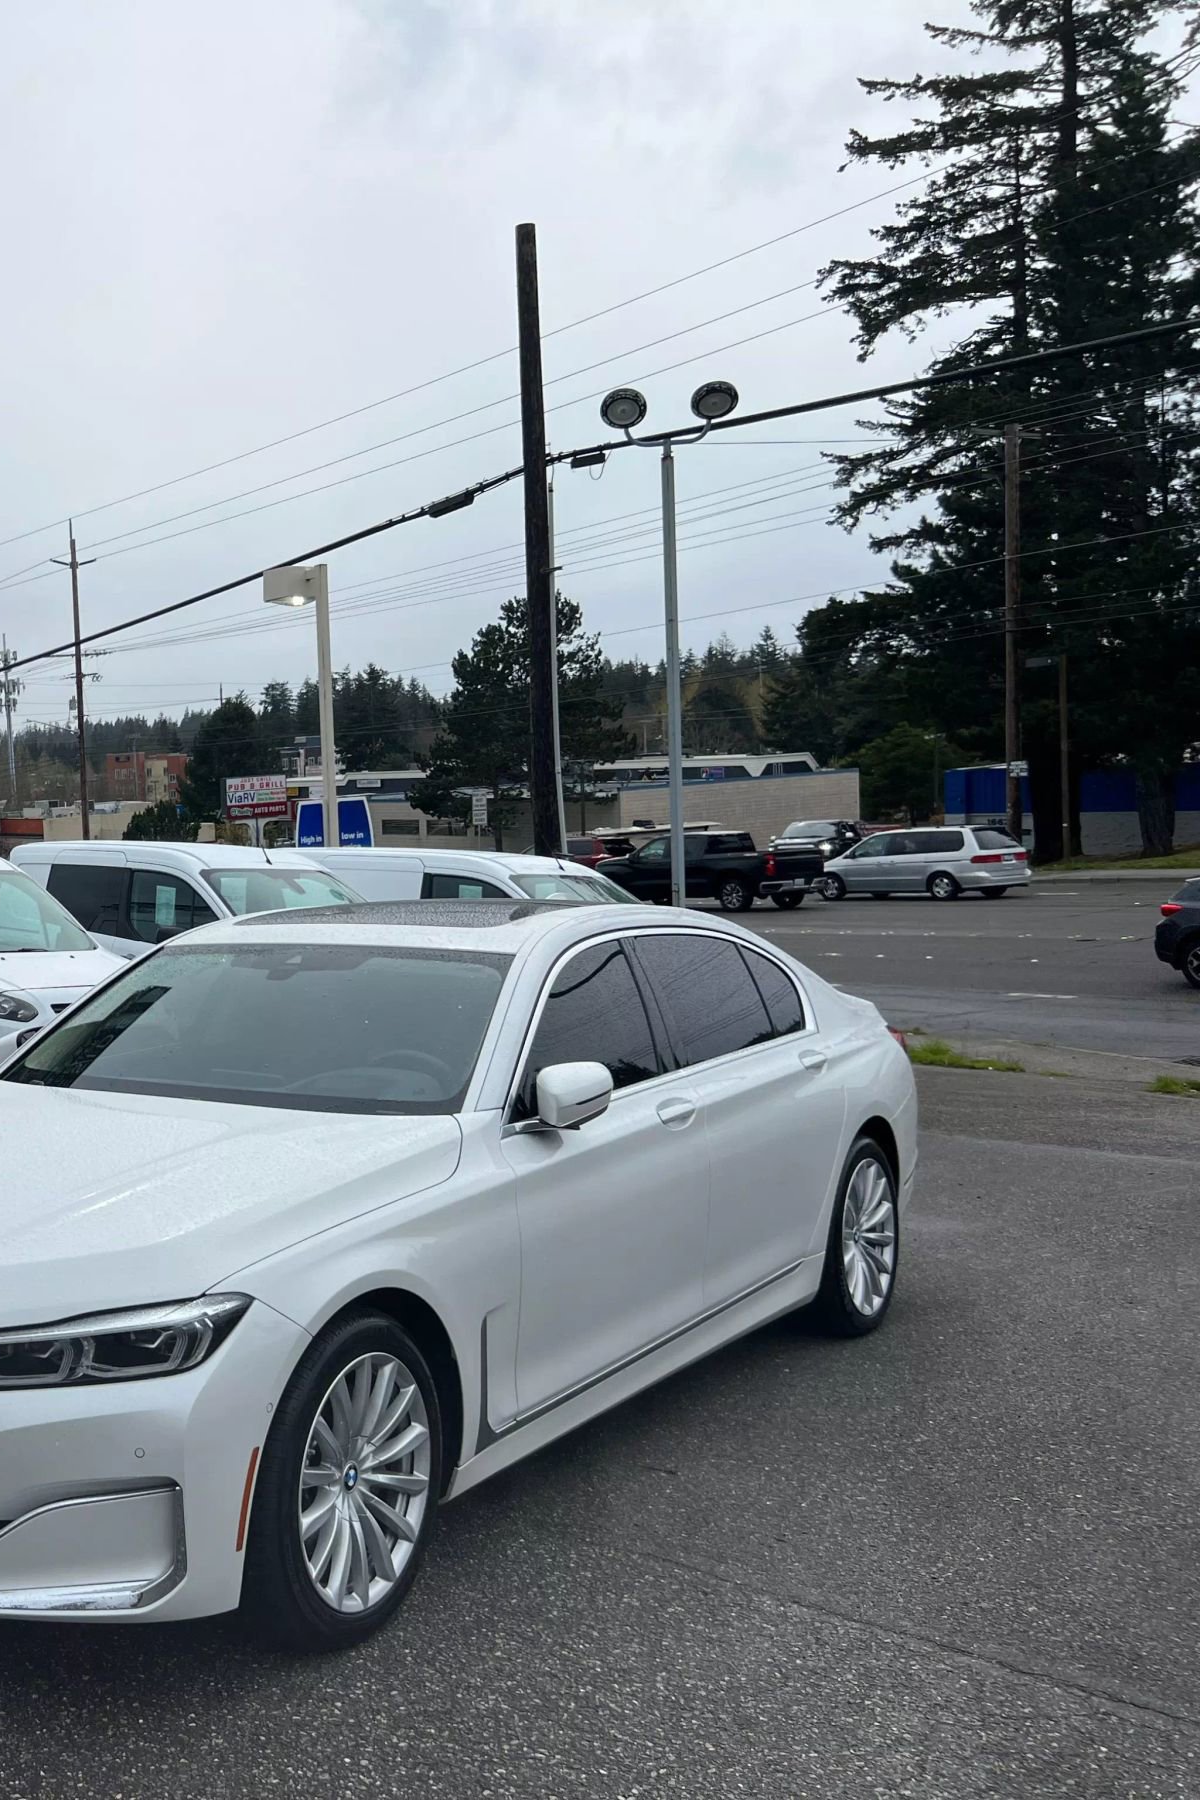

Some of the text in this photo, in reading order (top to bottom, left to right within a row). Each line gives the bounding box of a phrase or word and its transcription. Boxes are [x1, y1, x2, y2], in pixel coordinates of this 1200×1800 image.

[260, 781, 284, 789] GRILL
[227, 792, 256, 804] ViaRV
[269, 805, 286, 813] PARTS
[315, 835, 322, 843] in
[356, 831, 364, 839] in
